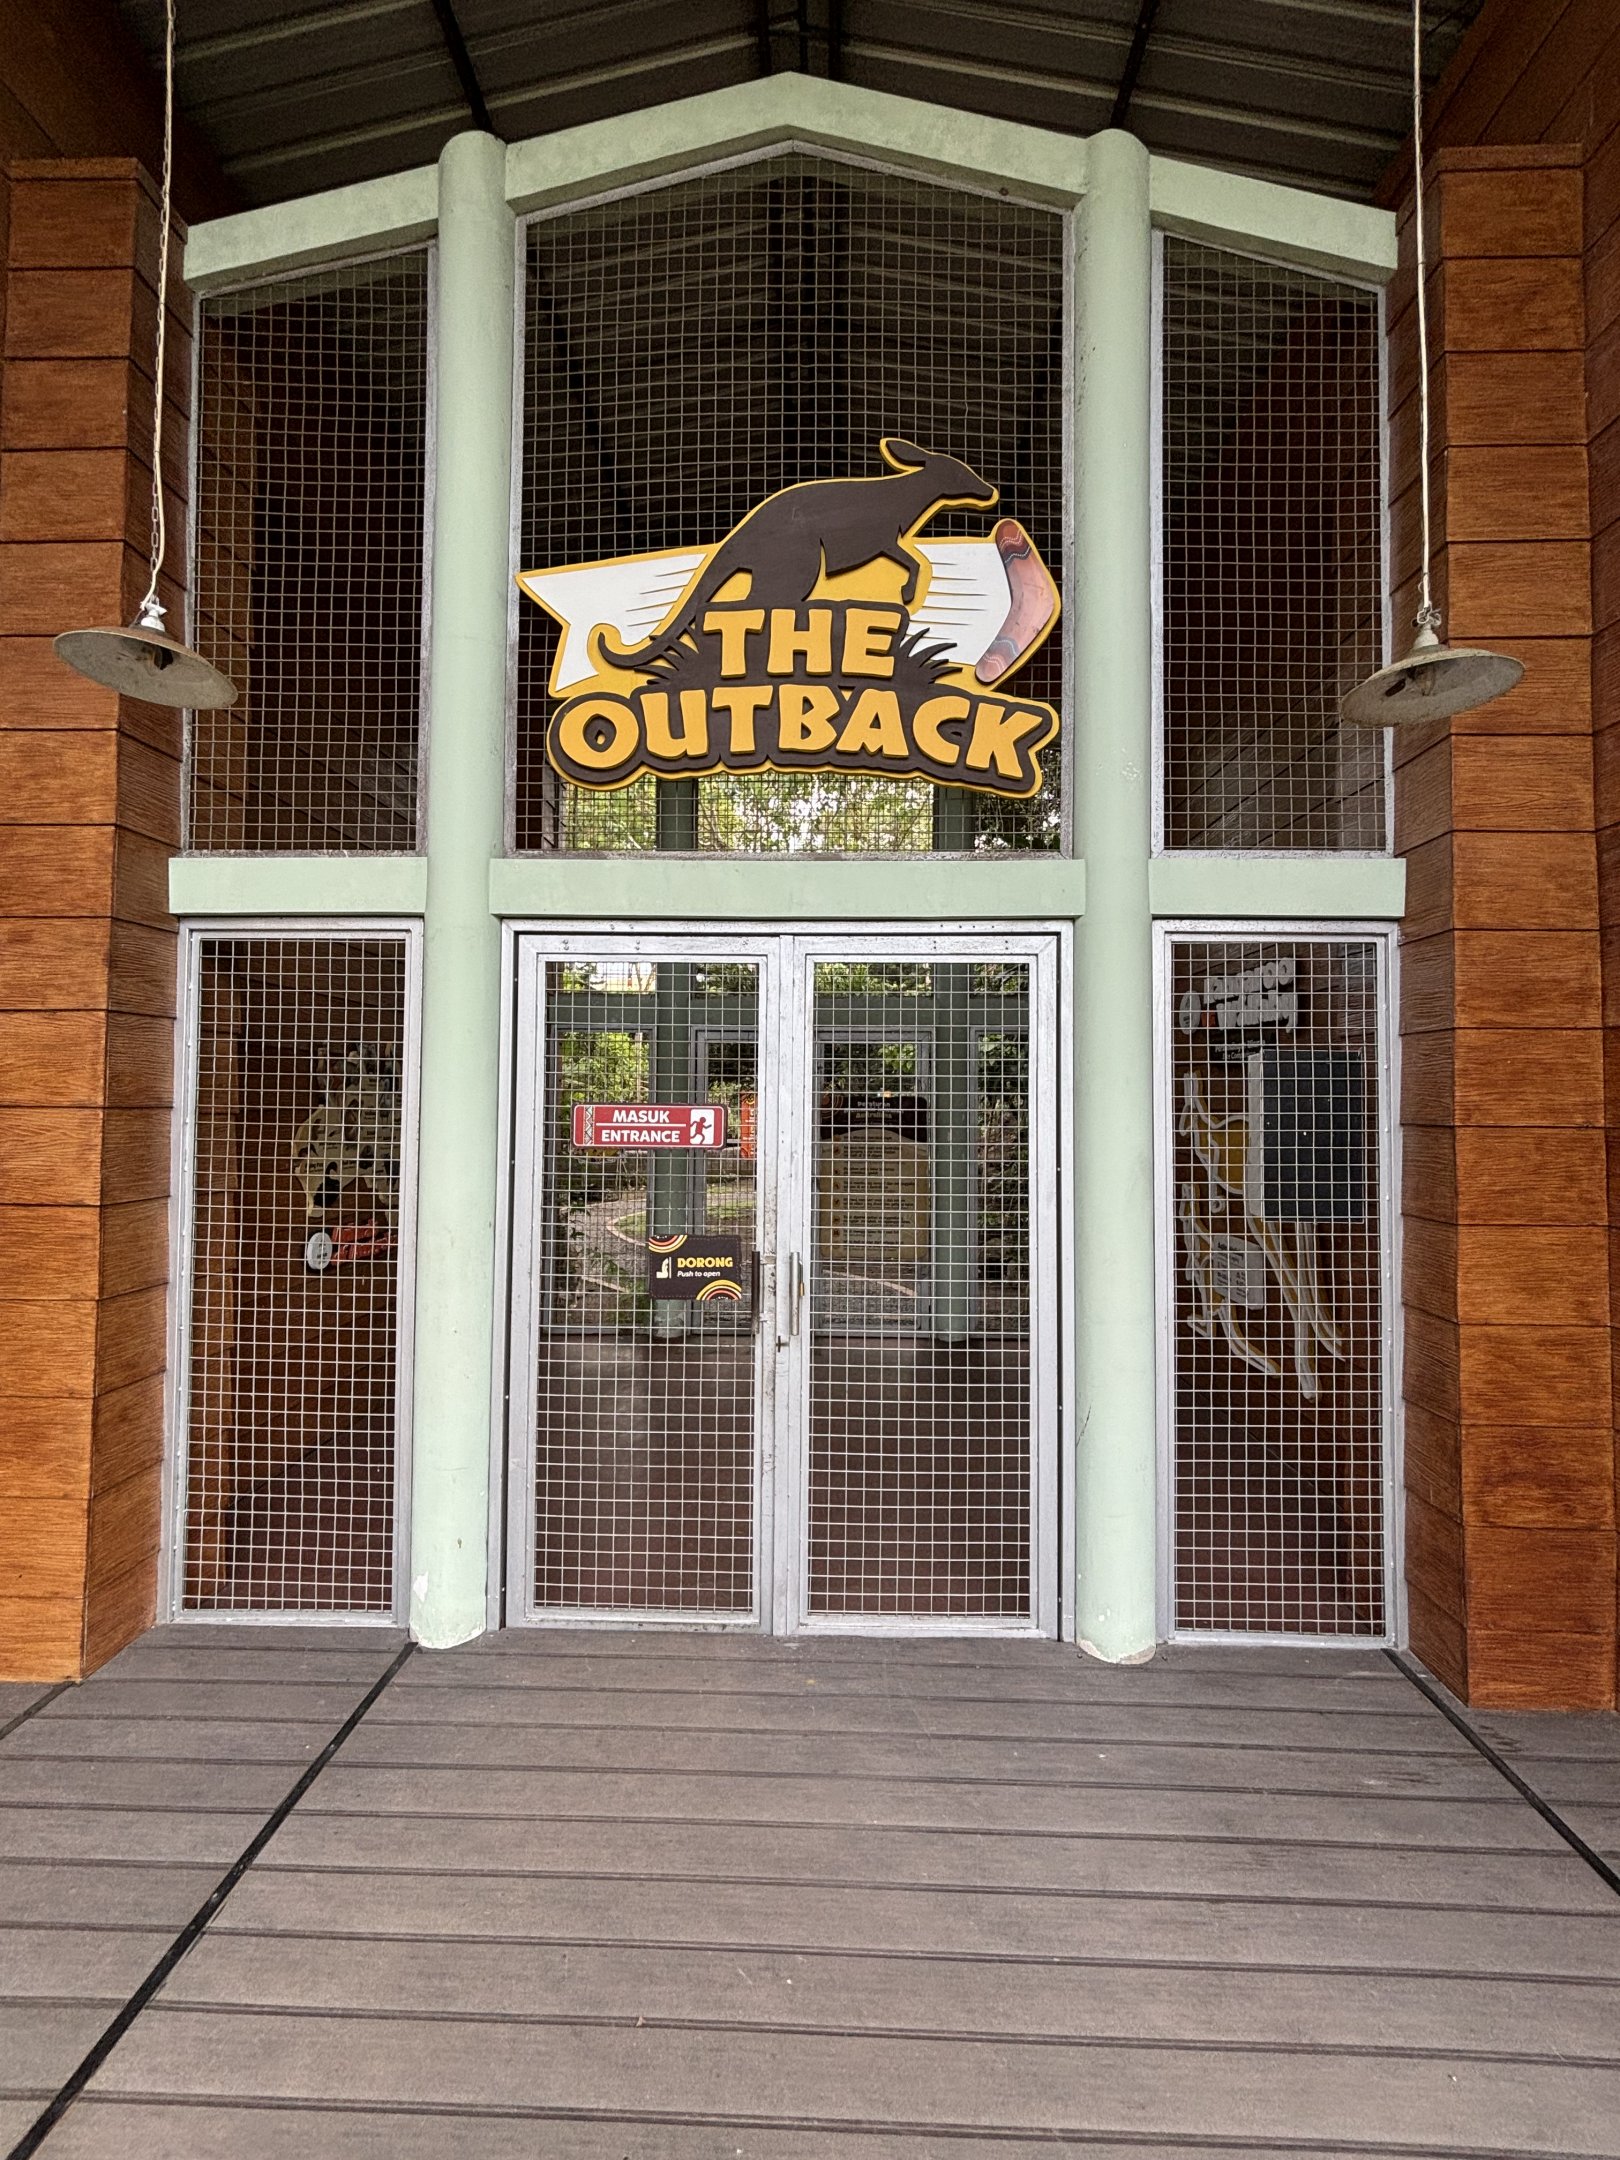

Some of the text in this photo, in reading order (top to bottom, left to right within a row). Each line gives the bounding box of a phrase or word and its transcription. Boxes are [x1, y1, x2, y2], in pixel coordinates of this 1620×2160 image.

[702, 607, 903, 678] THE
[558, 683, 1044, 780] OUTBACK
[613, 1110, 670, 1123] MASUK
[601, 1129, 681, 1143] ENTRANCE
[677, 1257, 734, 1268] DORONG
